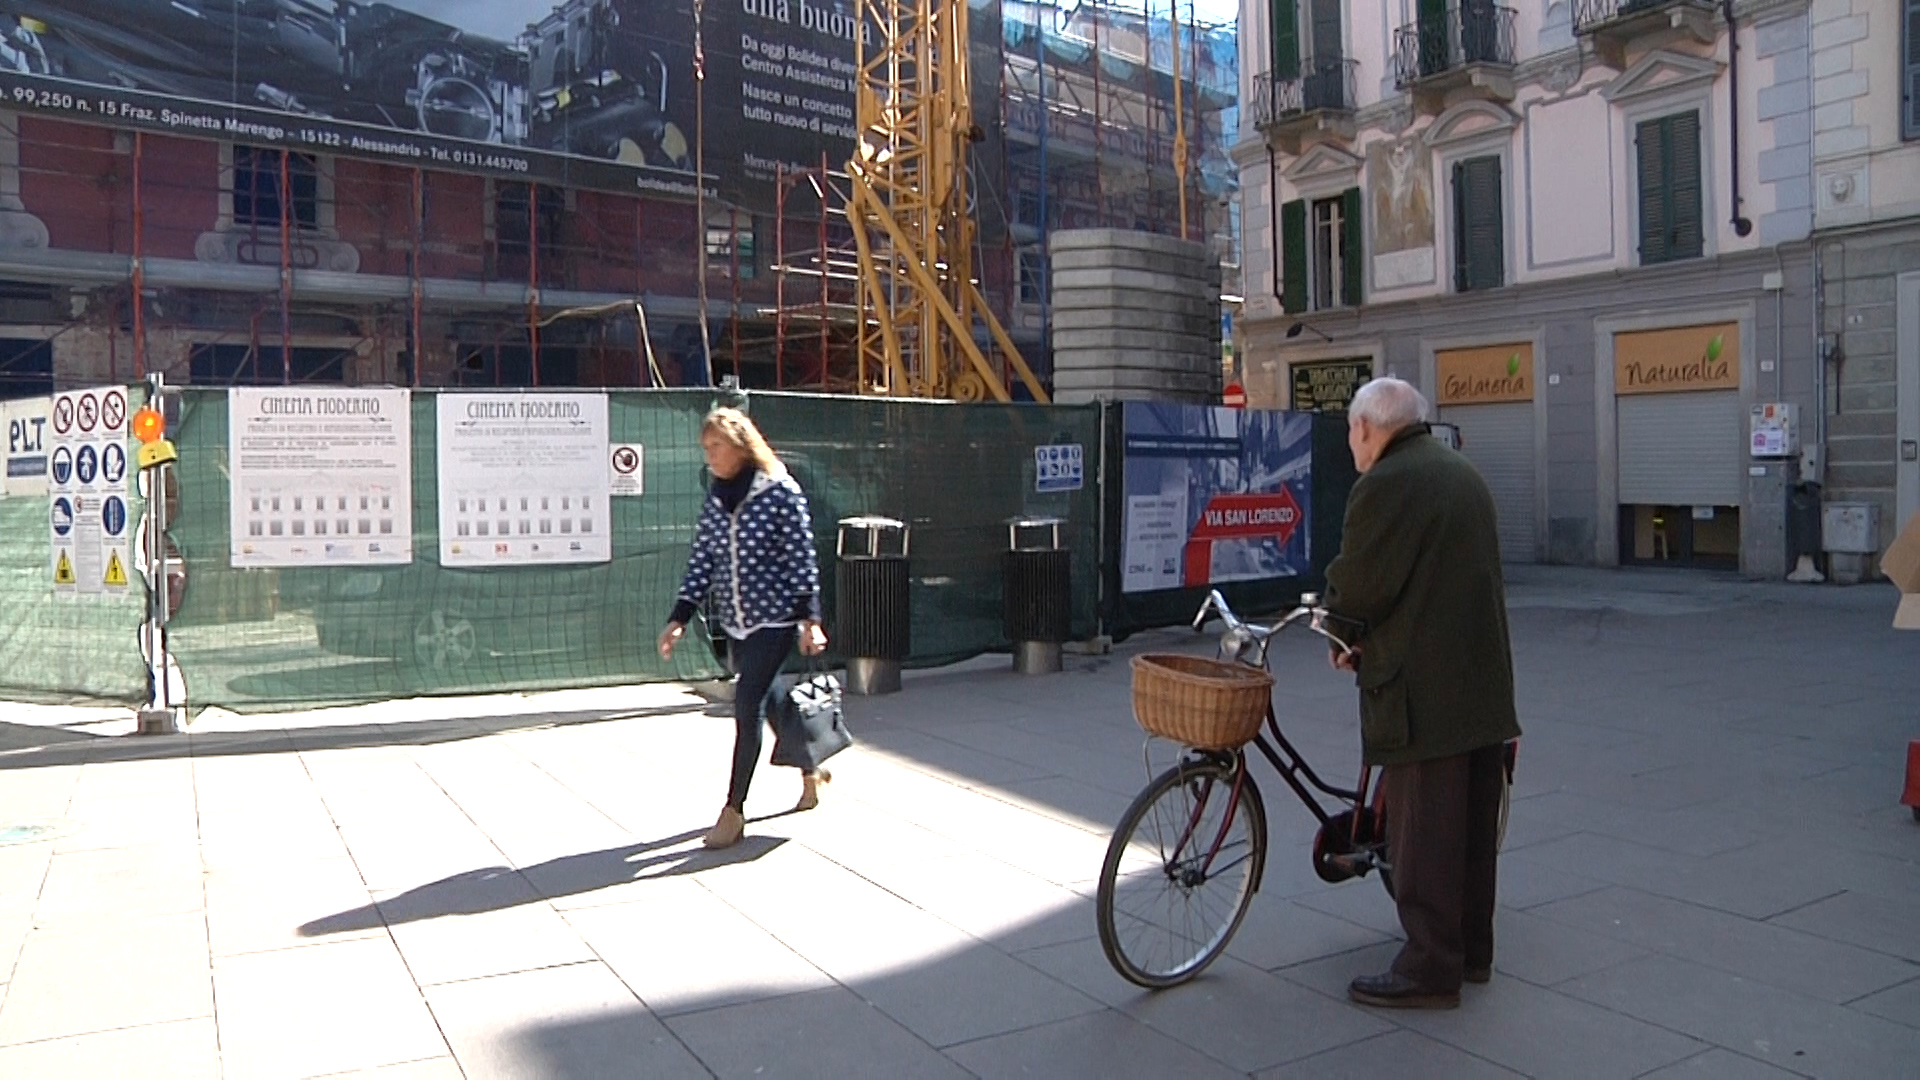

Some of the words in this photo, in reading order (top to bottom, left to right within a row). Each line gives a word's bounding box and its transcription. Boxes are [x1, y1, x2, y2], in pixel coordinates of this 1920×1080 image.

[800, 0, 872, 46] buona
[742, 34, 758, 52] Da
[760, 42, 786, 60] oggi
[742, 53, 783, 78] Centro
[785, 64, 846, 91] Assistenza
[742, 81, 782, 104] Nasce
[784, 94, 800, 108] un
[801, 97, 853, 119] concetto
[13, 86, 72, 109] 99,250
[76, 99, 91, 112] n.
[99, 100, 116, 114] 15
[120, 103, 156, 121] Fraz.
[161, 108, 222, 130] Spinetta
[225, 117, 284, 140] Marengo
[300, 129, 341, 146] 15122
[352, 136, 421, 157] Alessandria
[431, 147, 451, 160] Tel.
[743, 103, 772, 122] tutto
[773, 111, 808, 130] nuovo
[809, 117, 821, 132] di
[1625, 355, 1729, 386] Naturalia
[1445, 373, 1525, 400] Gelateria
[261, 397, 312, 415] CINEMA
[317, 396, 380, 415] MODERNO
[467, 401, 516, 418] CINEMA
[520, 401, 580, 418] MODERNO
[9, 417, 46, 452] PLT
[1204, 509, 1223, 526] VIA
[1224, 509, 1247, 526] SAN
[1248, 507, 1294, 525] LORENZO
